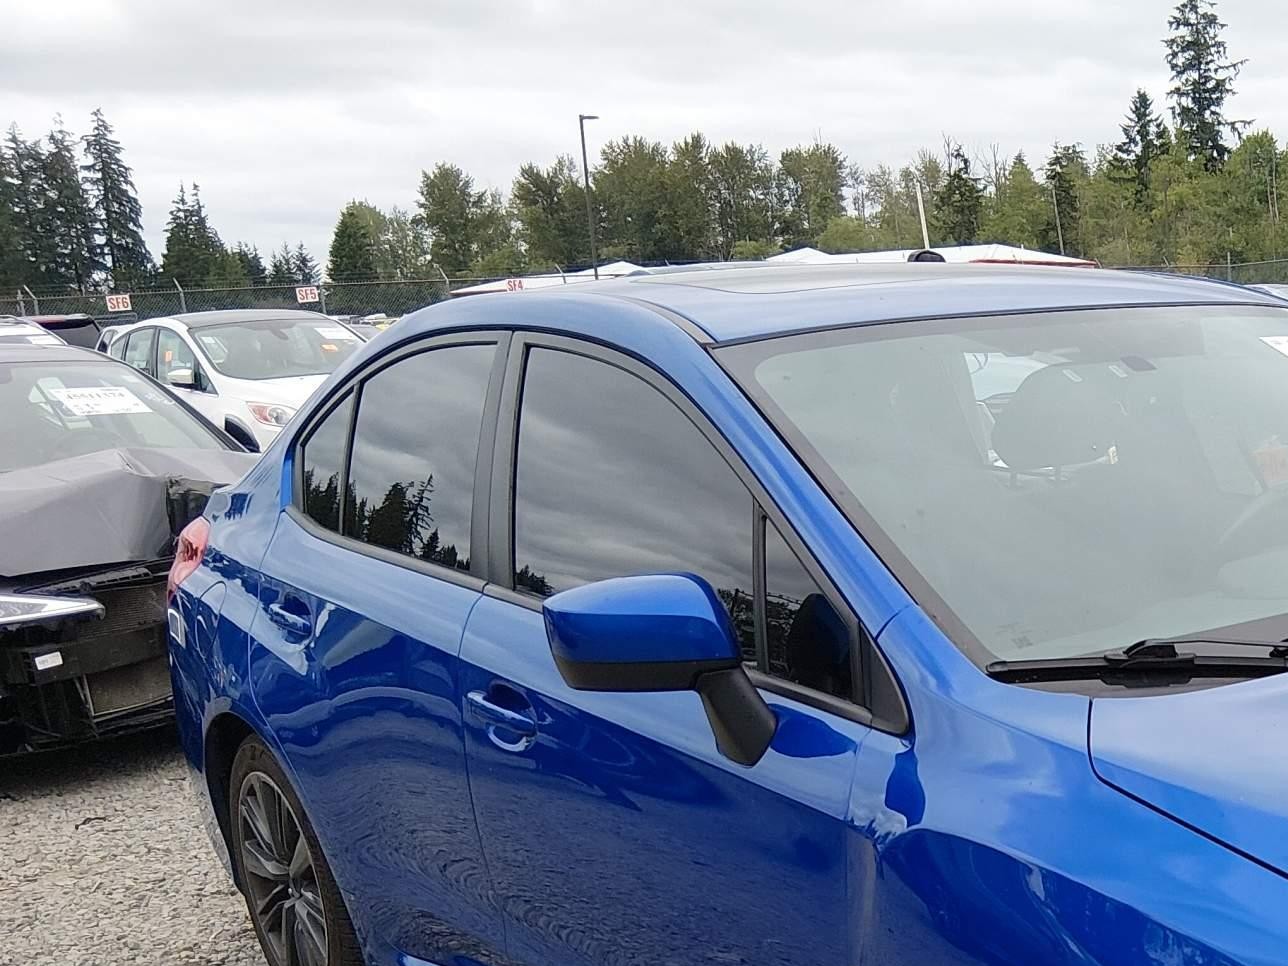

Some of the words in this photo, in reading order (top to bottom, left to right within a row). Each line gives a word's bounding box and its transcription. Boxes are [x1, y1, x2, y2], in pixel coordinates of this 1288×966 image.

[507, 279, 524, 292] SF4
[297, 288, 317, 301] SF5
[108, 296, 129, 310] SF6
